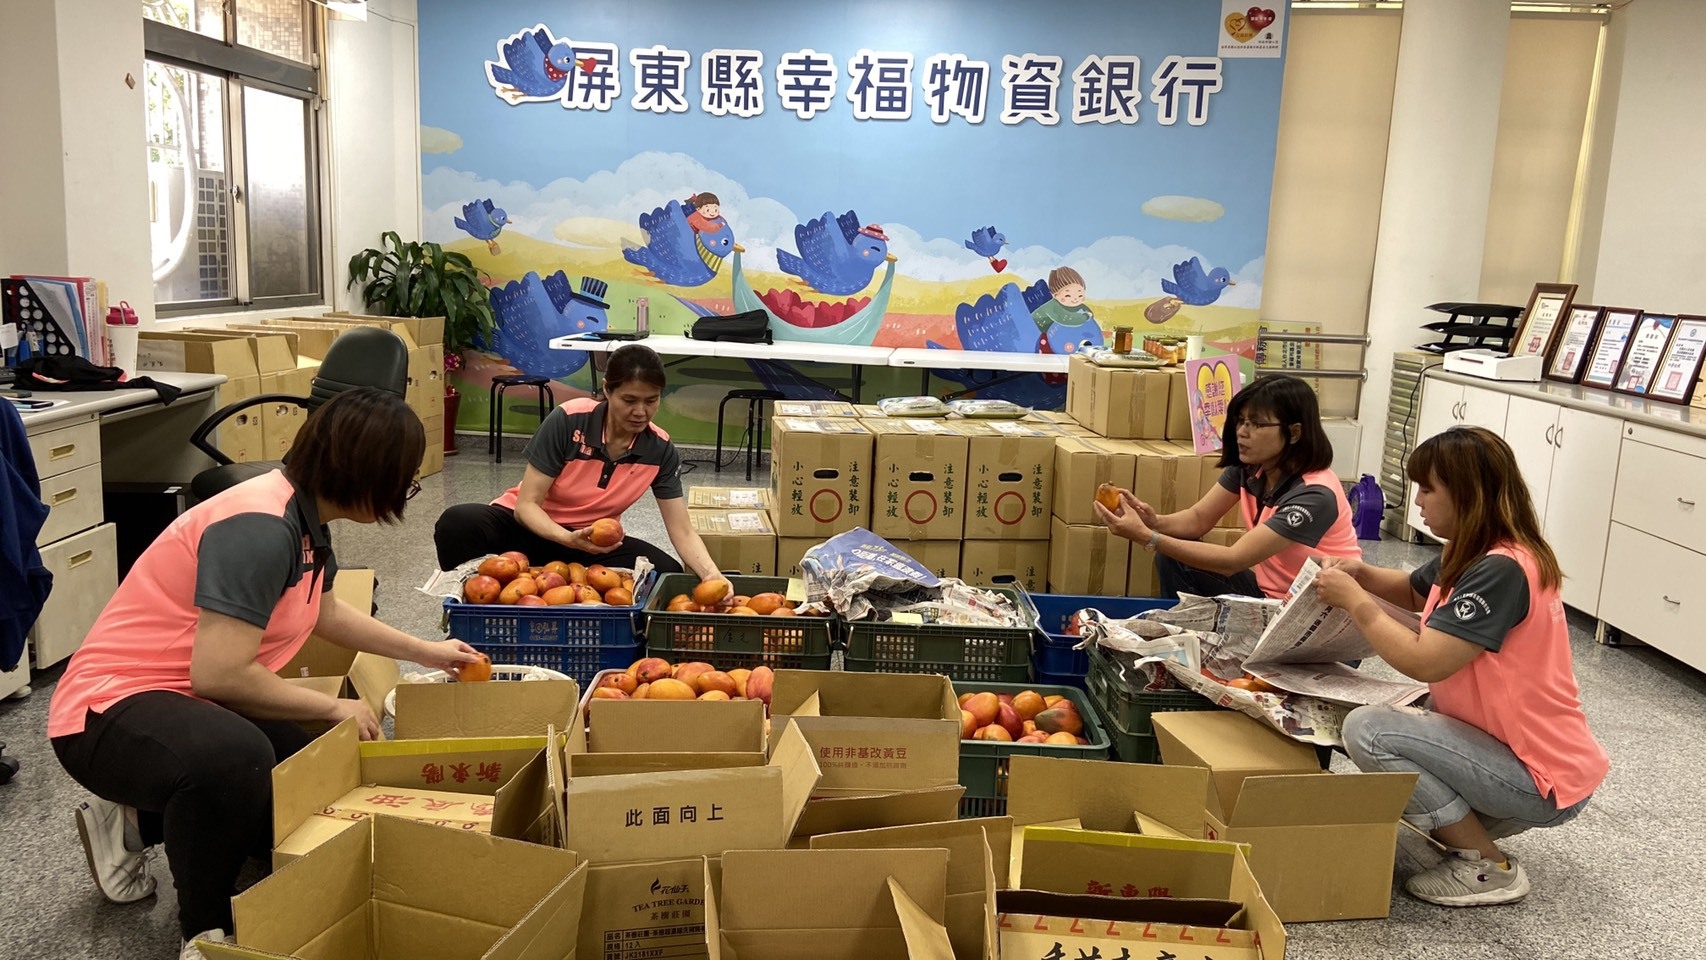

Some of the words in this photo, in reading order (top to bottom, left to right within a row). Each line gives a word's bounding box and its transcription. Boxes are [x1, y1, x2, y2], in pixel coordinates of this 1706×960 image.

[566, 47, 1218, 119] 屏東縣幸福物資銀行
[790, 461, 804, 516] 小心輕放
[847, 461, 860, 516] 注意裝卸
[886, 463, 900, 518] 小心輕放
[942, 463, 955, 518] 注意裝卸
[976, 464, 990, 519] 小心輕放
[1031, 463, 1043, 518] 注意裝卸
[789, 565, 800, 576] 小
[421, 761, 502, 785] 新東陽
[820, 746, 907, 759] 使用非基改黃豆
[625, 802, 724, 828] 此面向上
[632, 902, 650, 912] TEA
[651, 899, 675, 908] TREE
